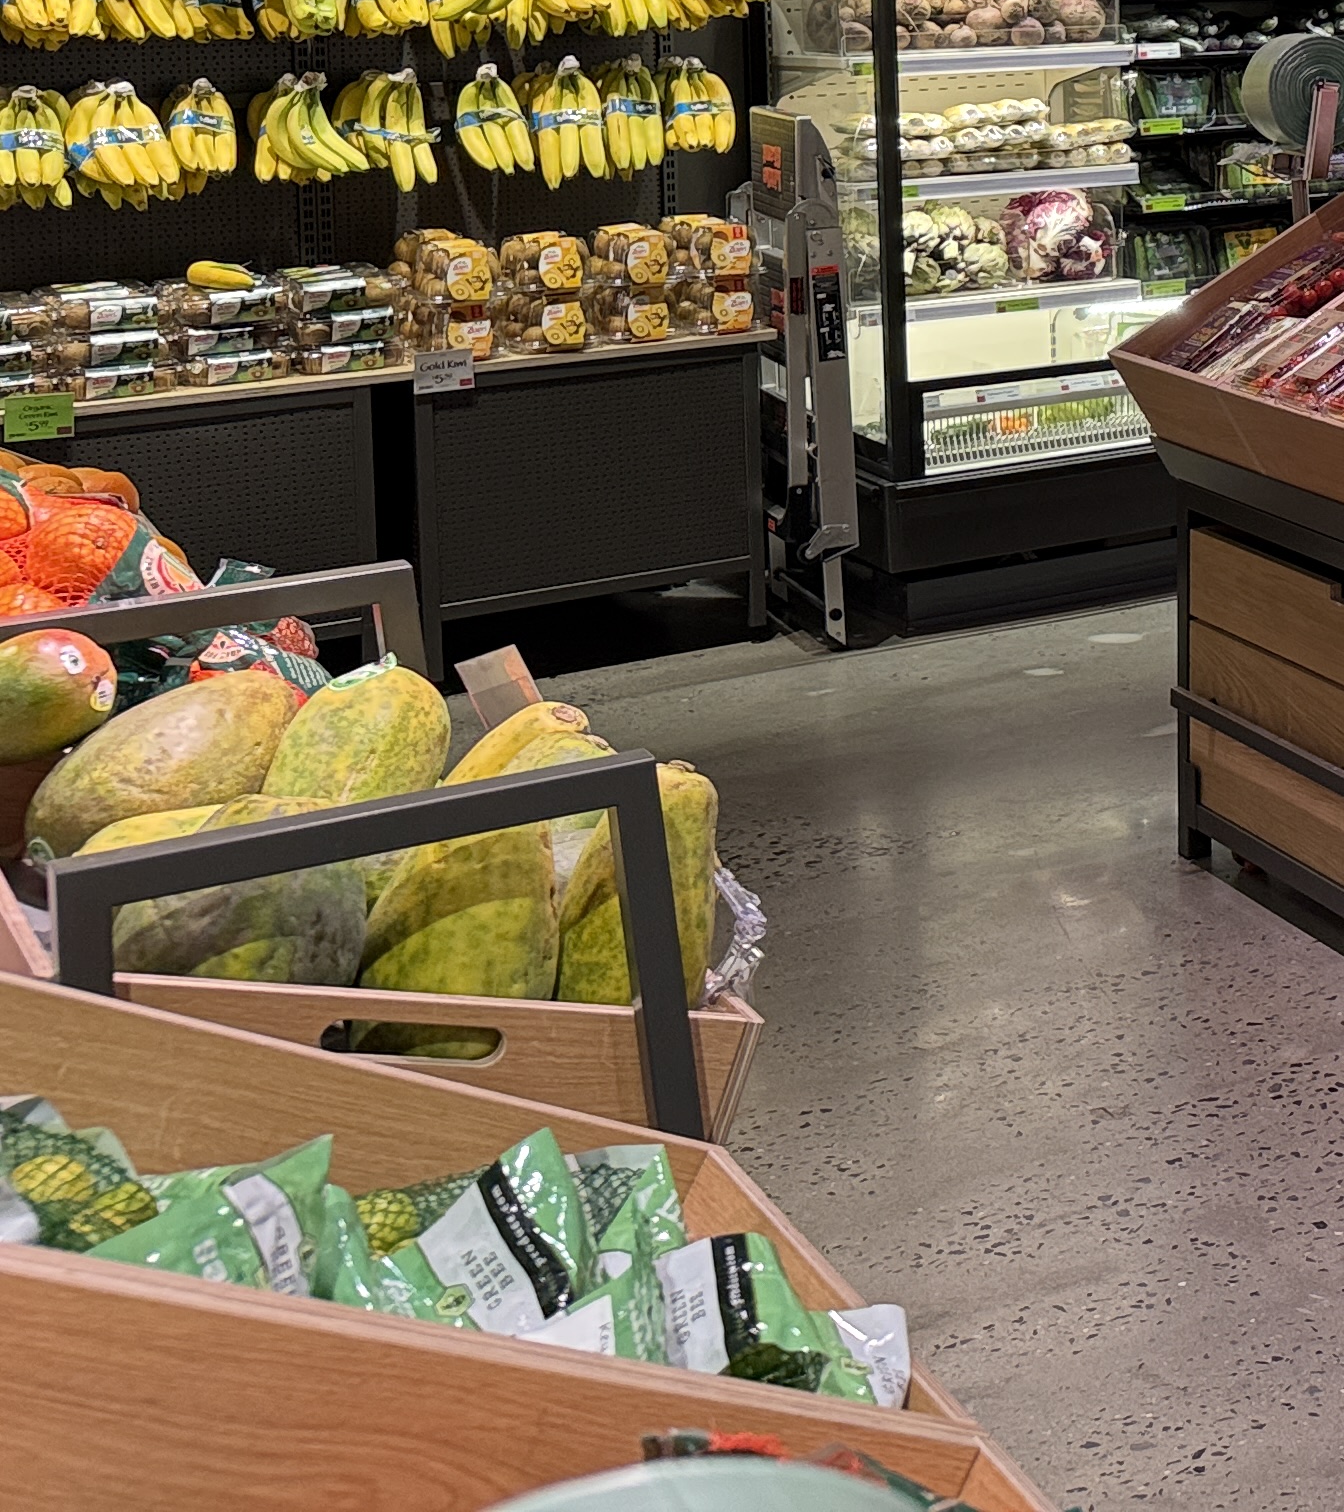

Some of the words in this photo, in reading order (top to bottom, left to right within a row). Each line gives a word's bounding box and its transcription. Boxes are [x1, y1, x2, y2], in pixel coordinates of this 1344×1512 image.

[419, 360, 446, 372] Gold
[447, 359, 468, 370] Kiwi
[18, 412, 44, 420] Green
[22, 404, 53, 413] Organic
[460, 1248, 503, 1312] GREEN
[482, 1250, 515, 1289] BEE
[669, 1288, 692, 1347] GREEN
[690, 1290, 707, 1324] BEE
